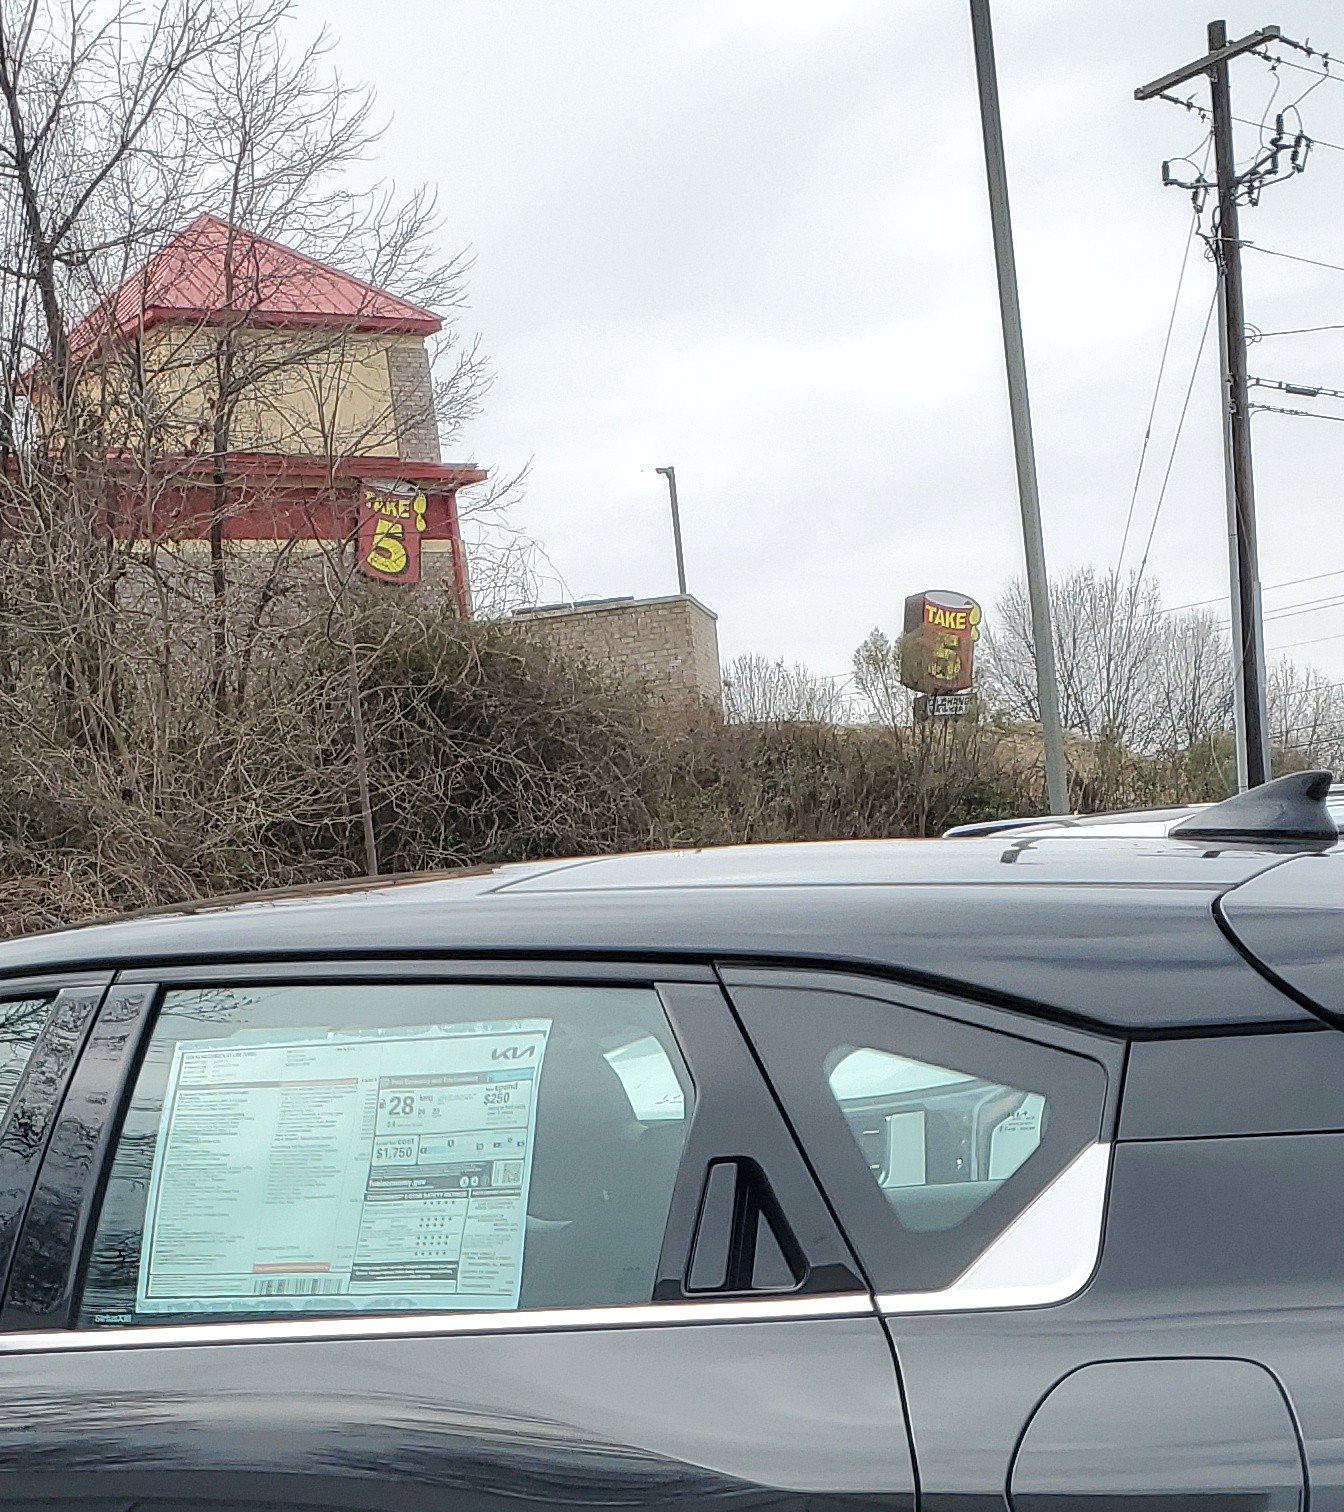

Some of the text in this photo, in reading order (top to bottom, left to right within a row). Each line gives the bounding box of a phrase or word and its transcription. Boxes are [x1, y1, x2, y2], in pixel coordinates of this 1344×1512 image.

[364, 490, 411, 518] TAKE
[367, 519, 407, 573] 5
[926, 605, 966, 629] TAKE
[928, 633, 960, 679] 5
[492, 1045, 536, 1060] KIA
[389, 1095, 415, 1116] 28
[484, 1092, 510, 1106] $250
[376, 1147, 413, 1159] $1,750
